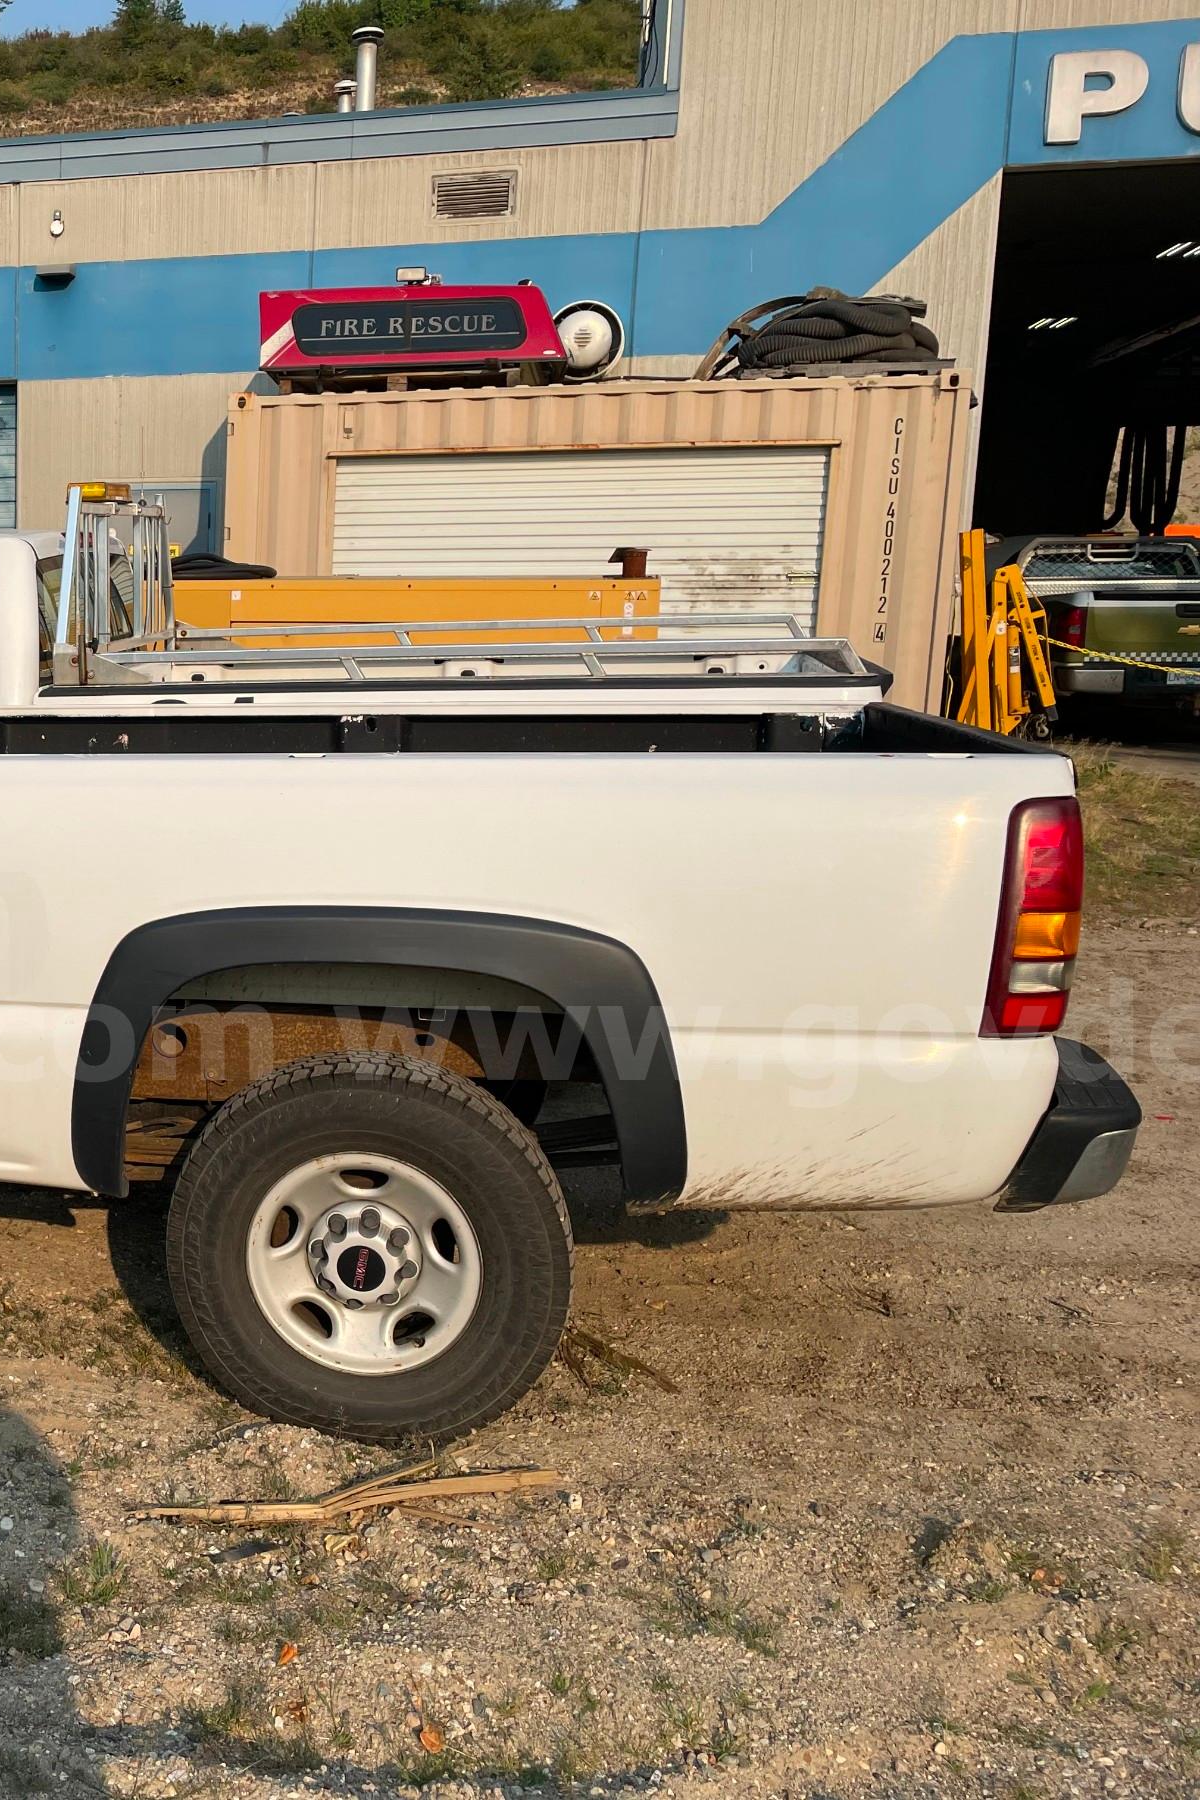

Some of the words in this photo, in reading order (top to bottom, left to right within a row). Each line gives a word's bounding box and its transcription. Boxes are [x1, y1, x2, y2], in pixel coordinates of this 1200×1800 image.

[1044, 43, 1200, 146] P
[320, 318, 377, 337] FIRE
[388, 314, 497, 335] RESCUE
[888, 417, 904, 495] CISU
[877, 502, 895, 614] 400212
[874, 624, 885, 642] 4
[353, 1248, 369, 1289] GMC
